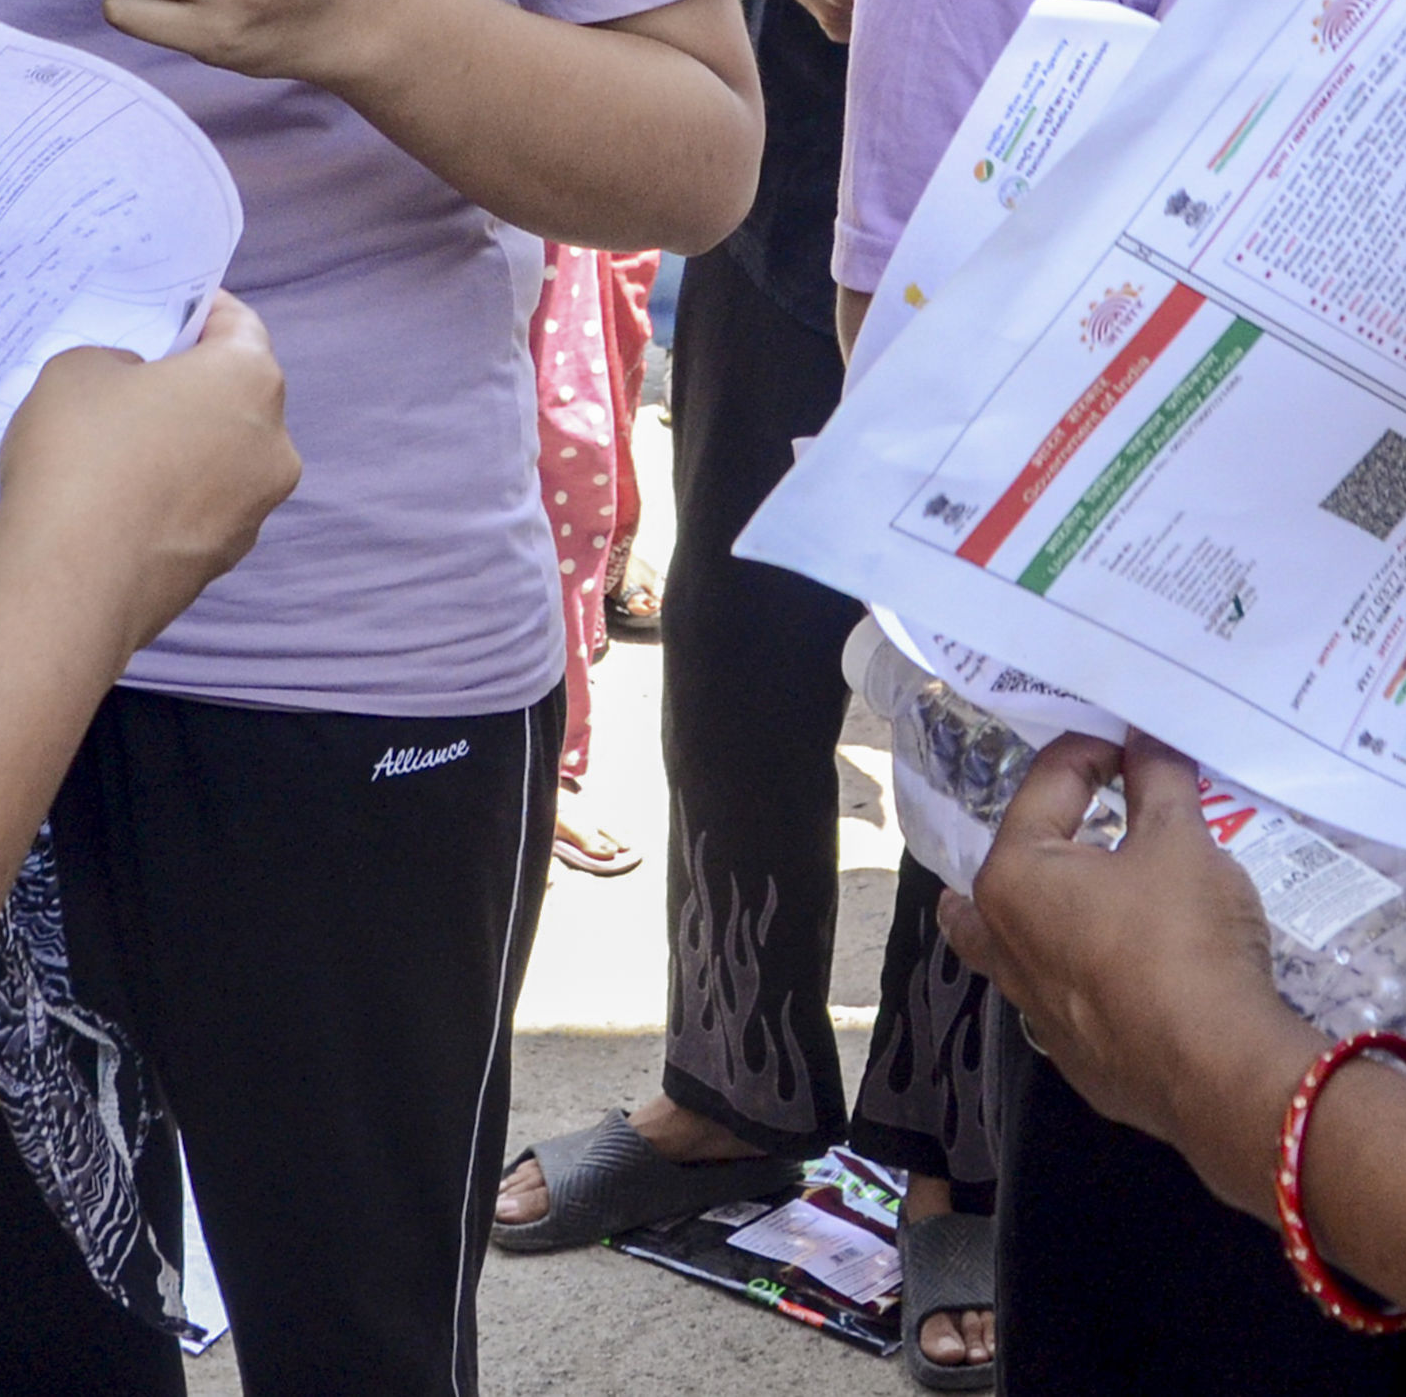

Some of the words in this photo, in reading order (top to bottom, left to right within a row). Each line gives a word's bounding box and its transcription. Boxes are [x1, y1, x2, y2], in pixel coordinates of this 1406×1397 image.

[1019, 409, 1104, 504] Government
[1097, 392, 1118, 413] of
[1111, 353, 1152, 396] India
[1045, 525, 1092, 576] Unique
[1149, 390, 1207, 453] Authority
[1209, 342, 1246, 381] India
[370, 738, 470, 783] Alliance
